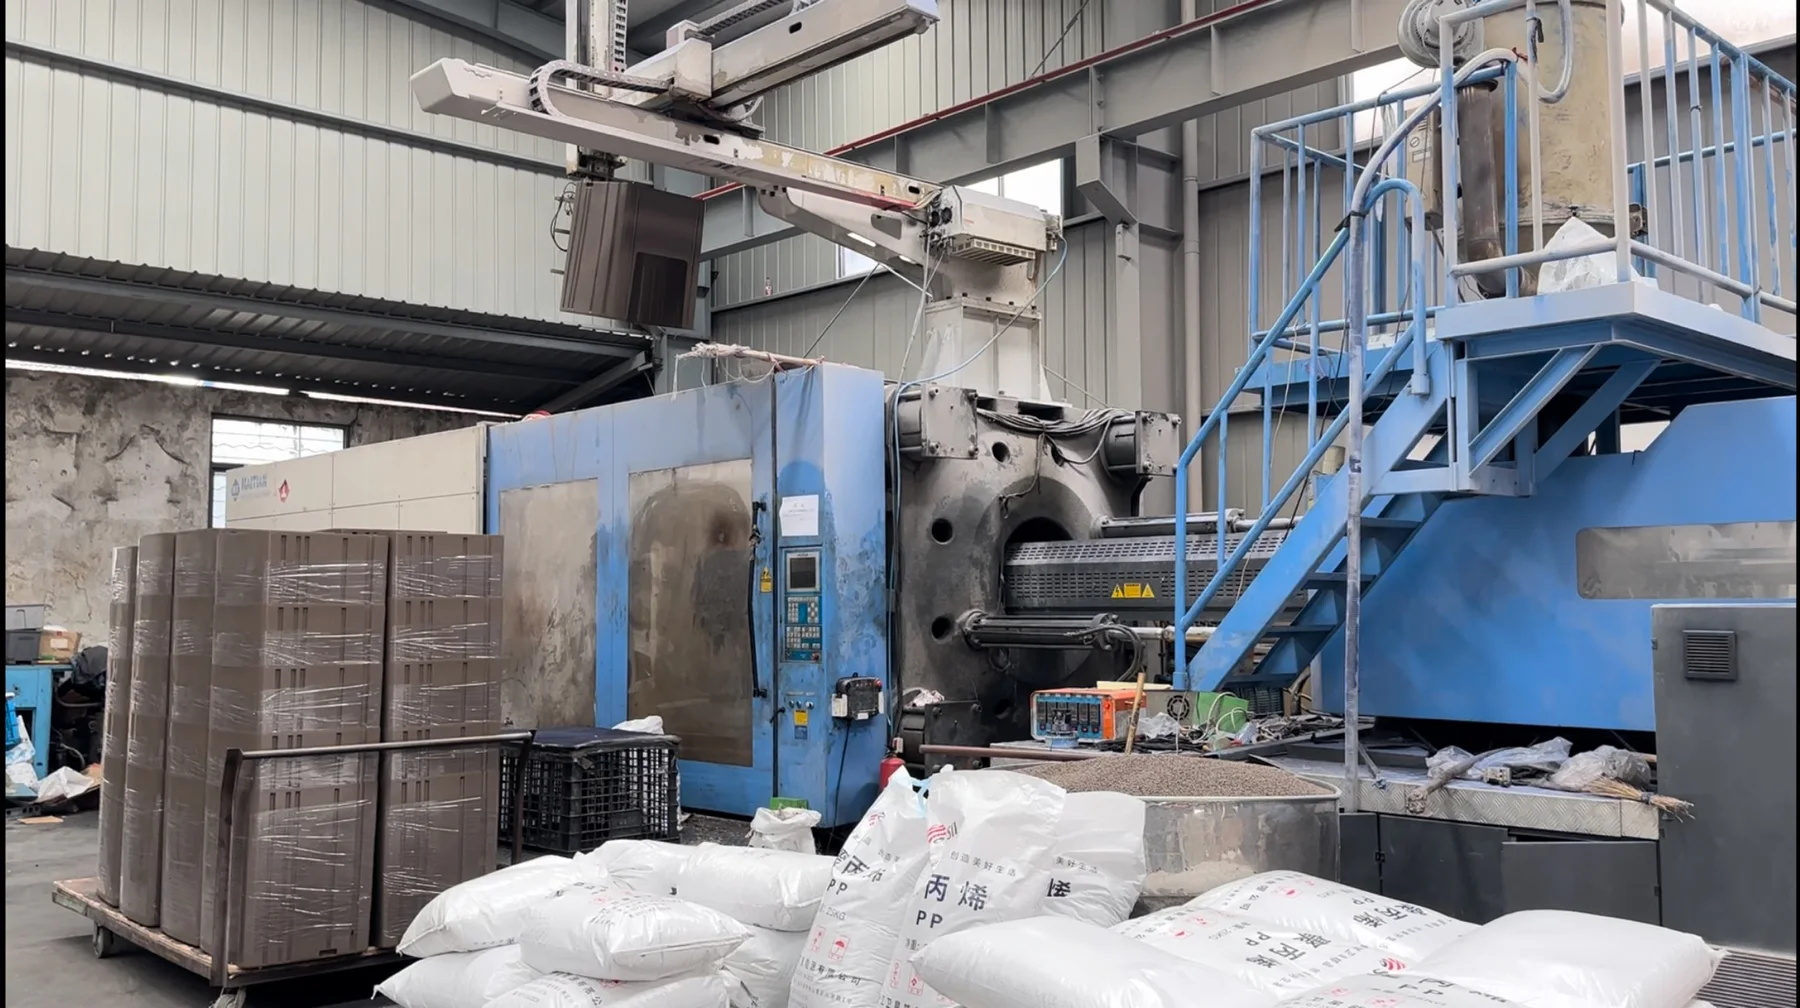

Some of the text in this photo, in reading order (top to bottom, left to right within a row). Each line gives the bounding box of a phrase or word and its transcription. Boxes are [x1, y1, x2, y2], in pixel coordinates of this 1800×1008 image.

[924, 873, 988, 912] 丙烯
[915, 910, 943, 929] PP
[1244, 930, 1272, 947] PP
[1245, 932, 1332, 969] 聚丙烯
